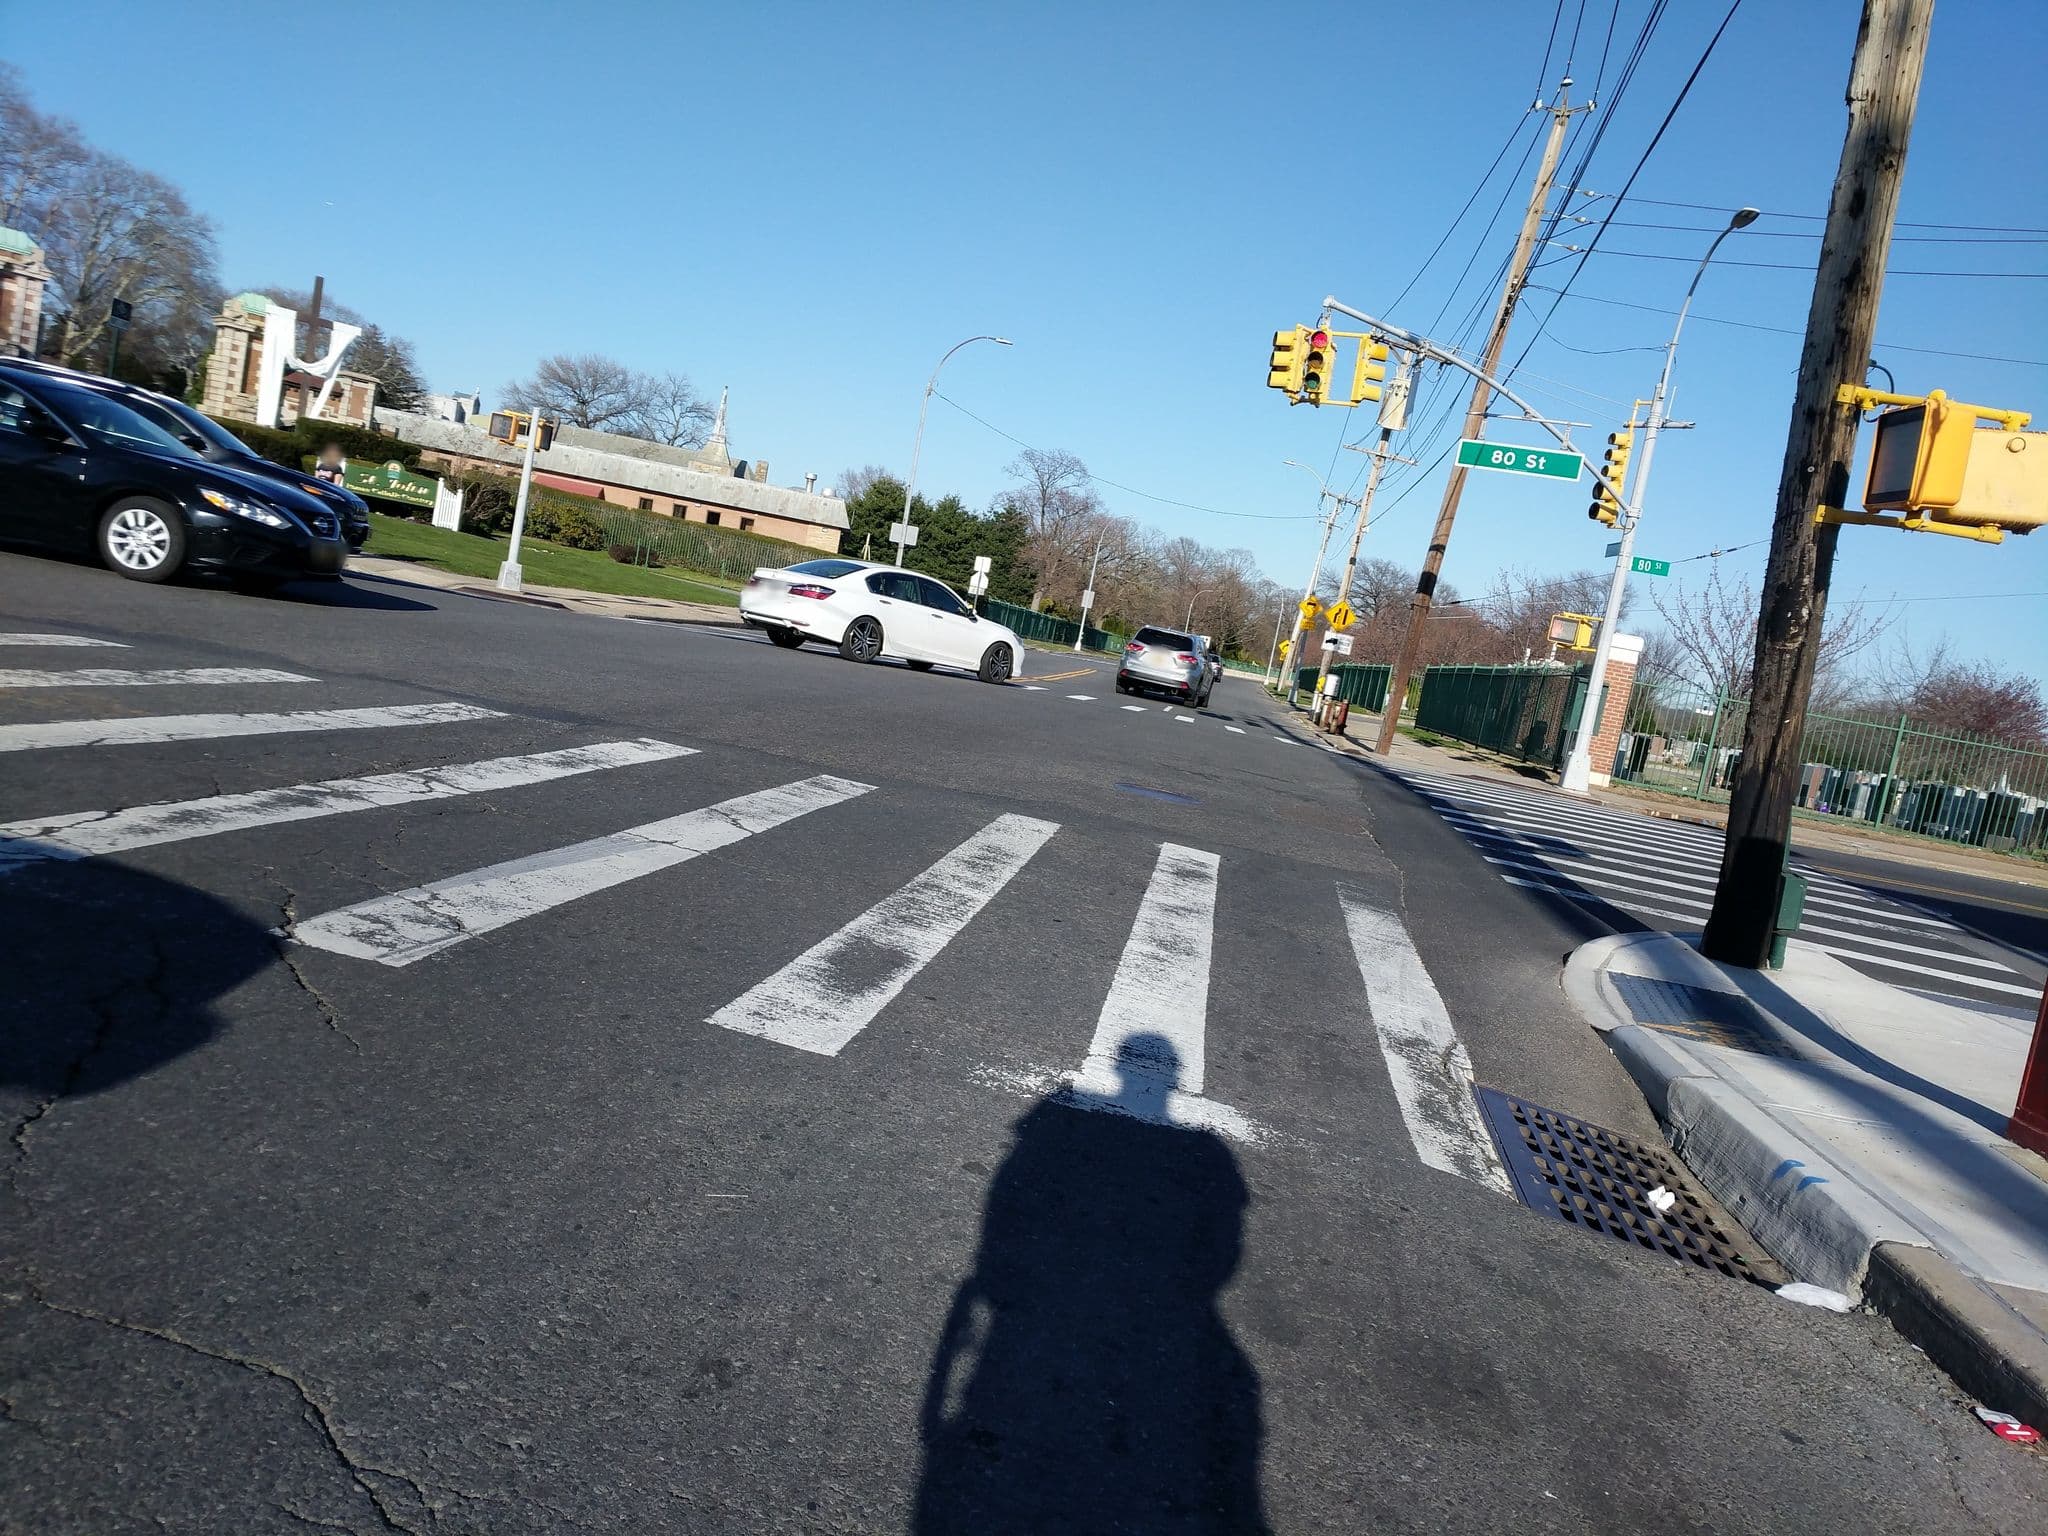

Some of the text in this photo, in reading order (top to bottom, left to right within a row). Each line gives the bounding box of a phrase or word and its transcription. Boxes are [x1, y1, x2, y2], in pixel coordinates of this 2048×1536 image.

[1491, 450, 1547, 470] 80 St
[1637, 559, 1652, 572] 80
